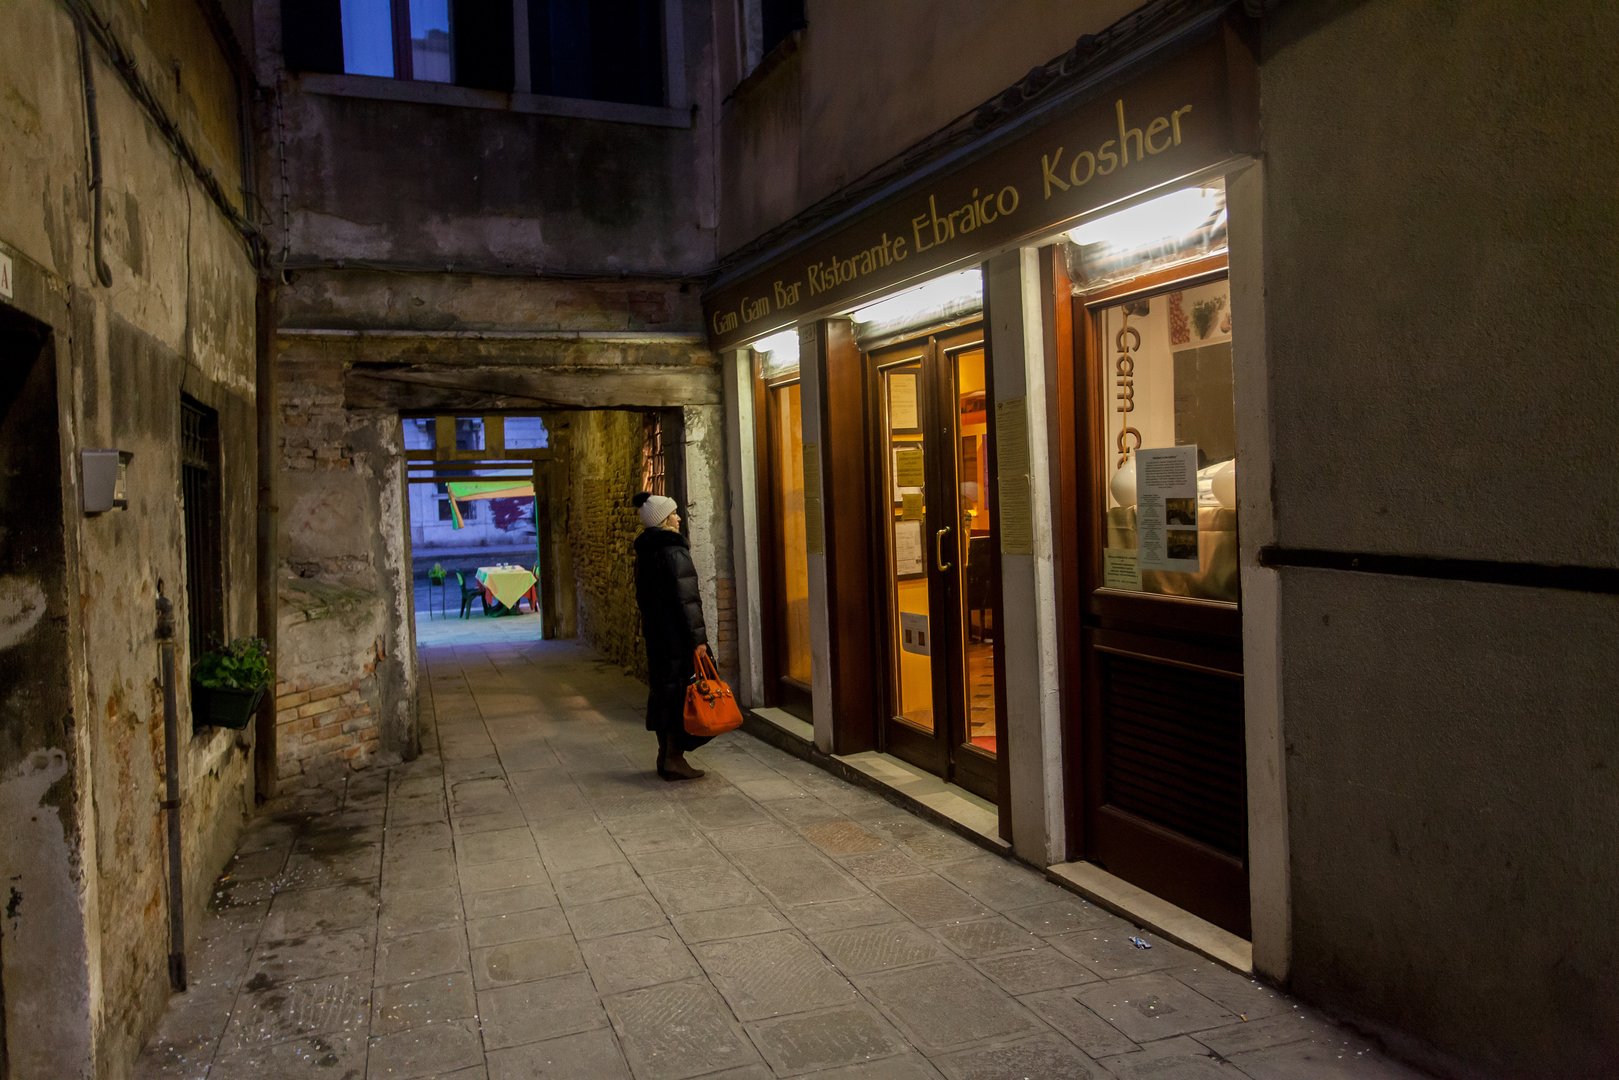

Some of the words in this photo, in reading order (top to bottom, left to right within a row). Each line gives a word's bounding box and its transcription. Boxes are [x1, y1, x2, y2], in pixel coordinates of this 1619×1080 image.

[713, 311, 738, 335] Gam
[741, 296, 770, 323] Gam
[773, 281, 801, 310] Bar
[807, 232, 908, 296] Ristorante
[911, 186, 1019, 253] Ebraico
[1041, 99, 1193, 200] Kosher
[1, 263, 9, 289] A
[1115, 326, 1141, 413] Gam
